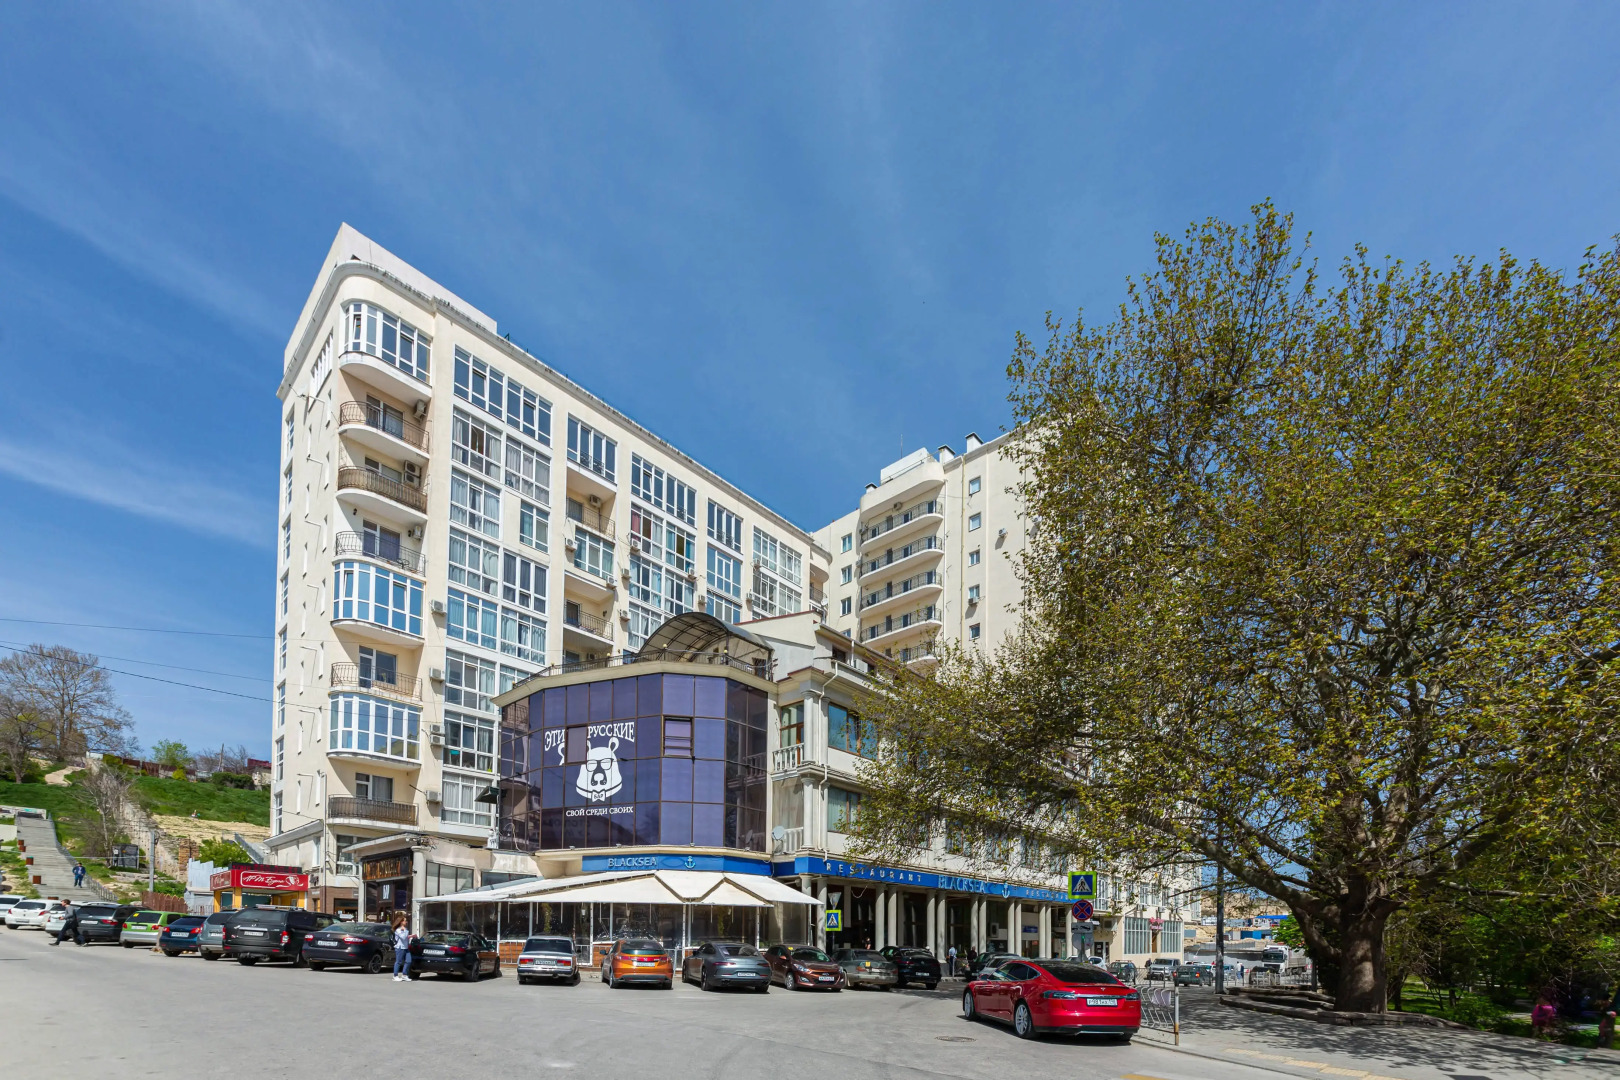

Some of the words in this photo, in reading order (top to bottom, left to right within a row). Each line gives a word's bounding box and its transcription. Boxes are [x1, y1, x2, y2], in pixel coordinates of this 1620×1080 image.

[544, 729, 566, 752] ЭТИ
[587, 721, 635, 743] РУССКИЕ
[565, 808, 585, 817] СВОЙ
[585, 807, 608, 817] СРЕДИ
[608, 806, 634, 815] СВОИХ
[607, 856, 657, 868] BLACKSEA
[826, 862, 922, 883] RESTAURANT
[938, 875, 986, 894] BLACKSEA
